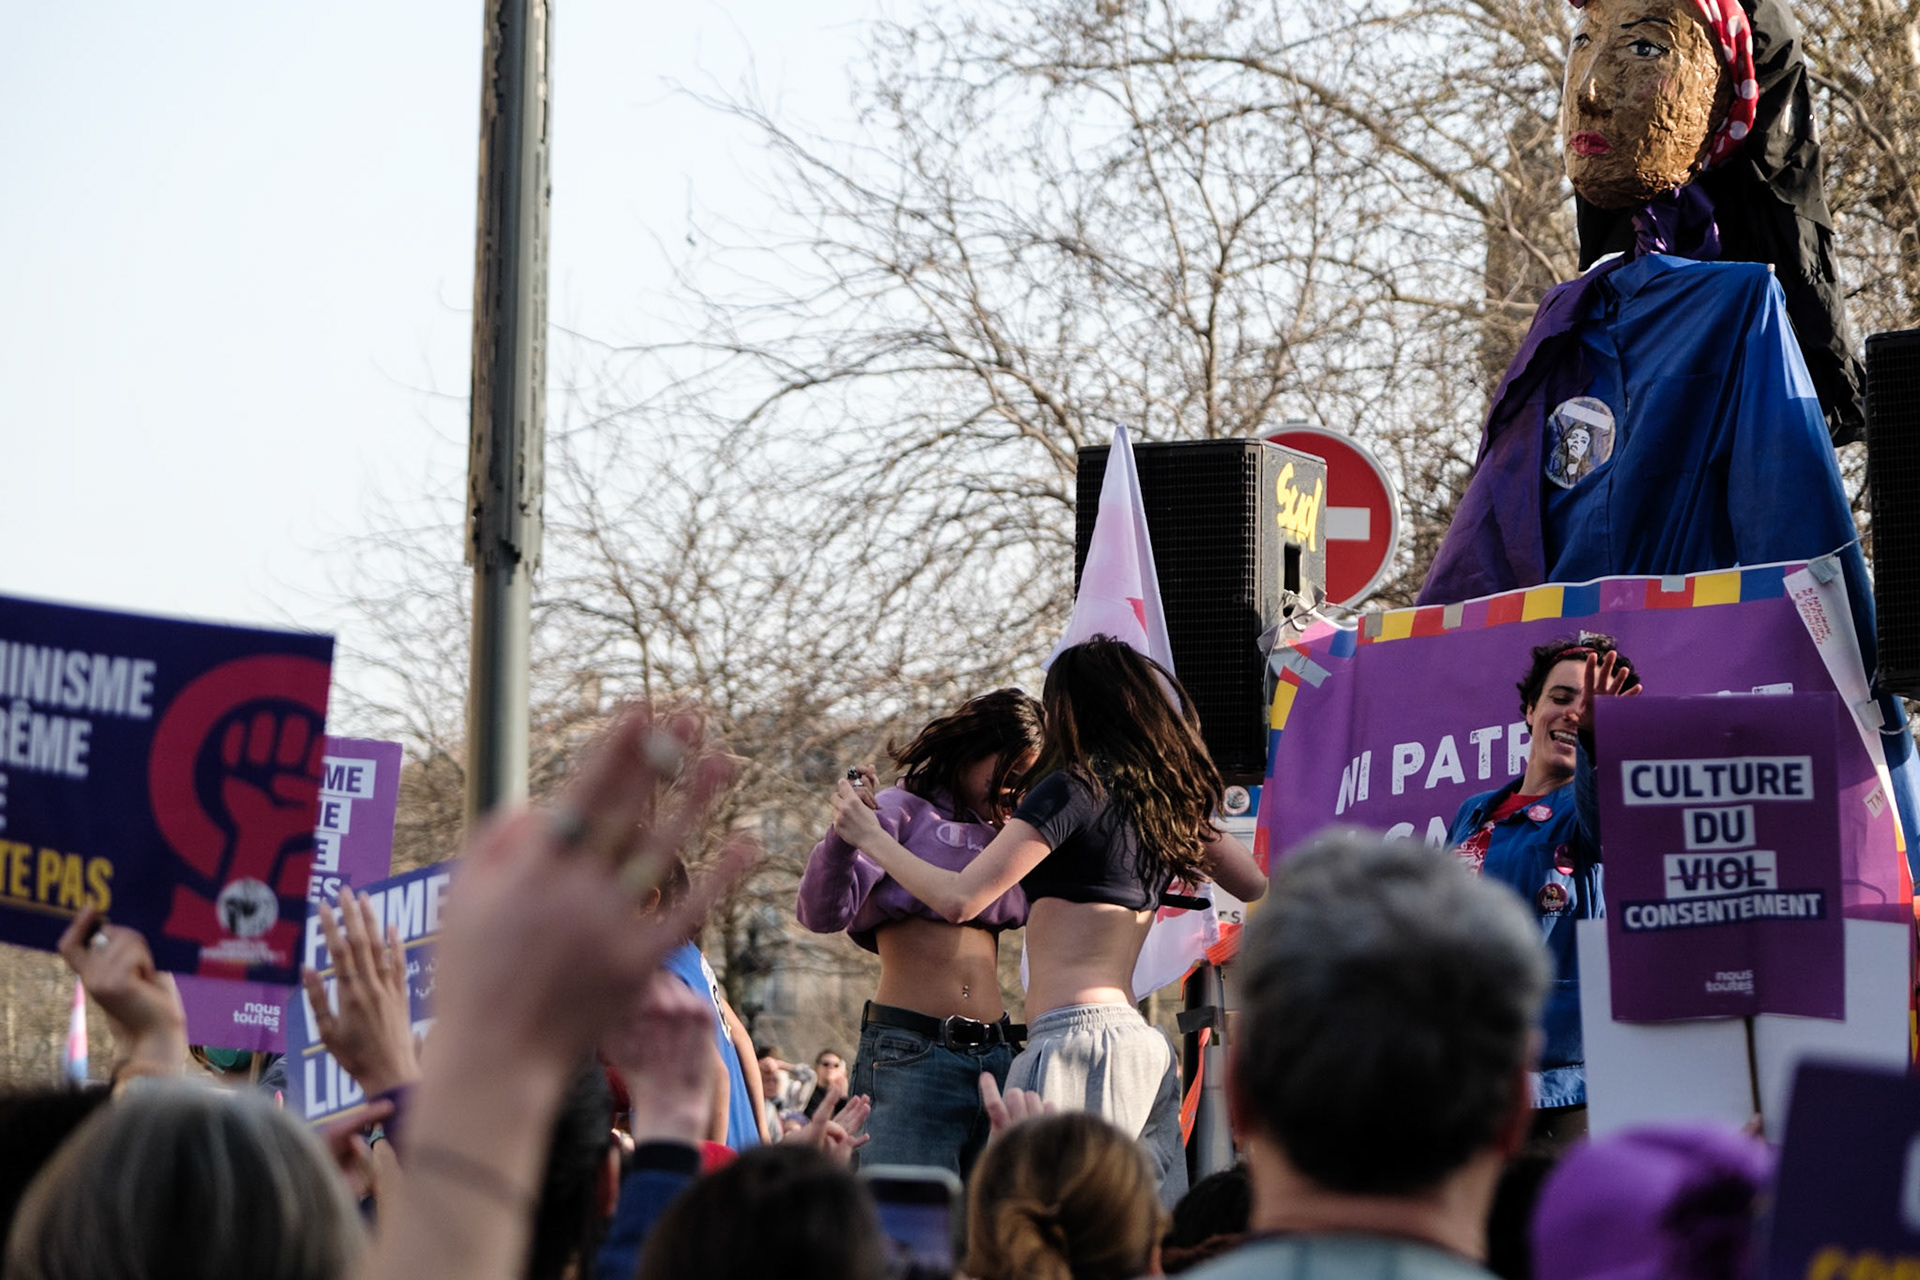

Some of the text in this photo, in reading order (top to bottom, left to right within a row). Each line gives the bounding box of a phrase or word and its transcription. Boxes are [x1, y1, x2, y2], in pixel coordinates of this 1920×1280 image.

[1335, 750, 1372, 816] NI
[1630, 762, 1804, 798] CULTURE
[1693, 809, 1746, 844] DU
[36, 847, 114, 915] PAS
[1676, 854, 1767, 892] VIOL
[1625, 893, 1822, 929] CONSENTEMENT
[233, 1010, 280, 1027] toutes
[244, 1001, 281, 1016] nous
